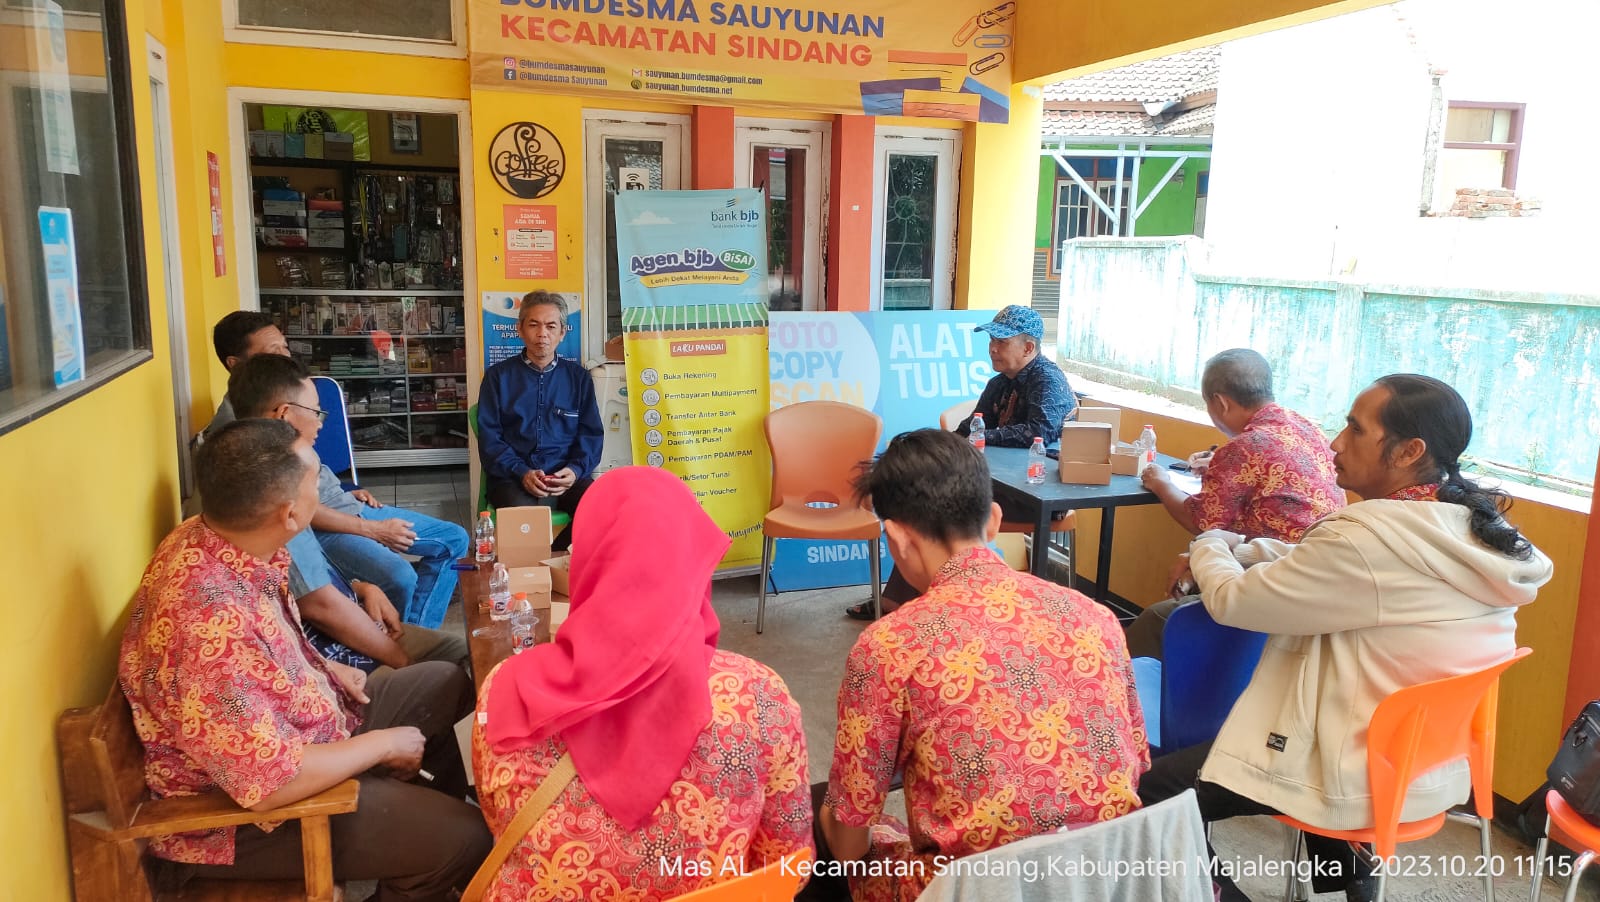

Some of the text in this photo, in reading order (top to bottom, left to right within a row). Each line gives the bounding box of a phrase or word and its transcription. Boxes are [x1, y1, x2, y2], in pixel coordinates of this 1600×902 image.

[709, 1, 885, 38] SAUYUNAN
[500, 14, 873, 67] KECAMATAN SINDANG
[571, 75, 608, 86] Sauyunan
[645, 69, 763, 85] sauyunan.bumdesma@gmail.com
[645, 81, 733, 95] sauyunan.bumdesma.net
[711, 209, 760, 223] bank bjb
[630, 248, 715, 273] Agen bjb
[889, 322, 977, 359] ALAT
[672, 343, 724, 353] LAKU PANDAI
[769, 351, 845, 380] COPY
[683, 371, 717, 380] Rekening
[664, 388, 758, 401] Pembayaran Multipayment
[666, 413, 696, 421] Transfer
[698, 411, 717, 419] Antar
[667, 426, 733, 438] Pembayaran Pajak
[667, 437, 694, 446] Daerah
[702, 436, 722, 444] Pusat
[668, 449, 753, 463] Pembayaran PDAM/PAM
[710, 471, 730, 479] Tunai
[709, 488, 737, 496] Voucher
